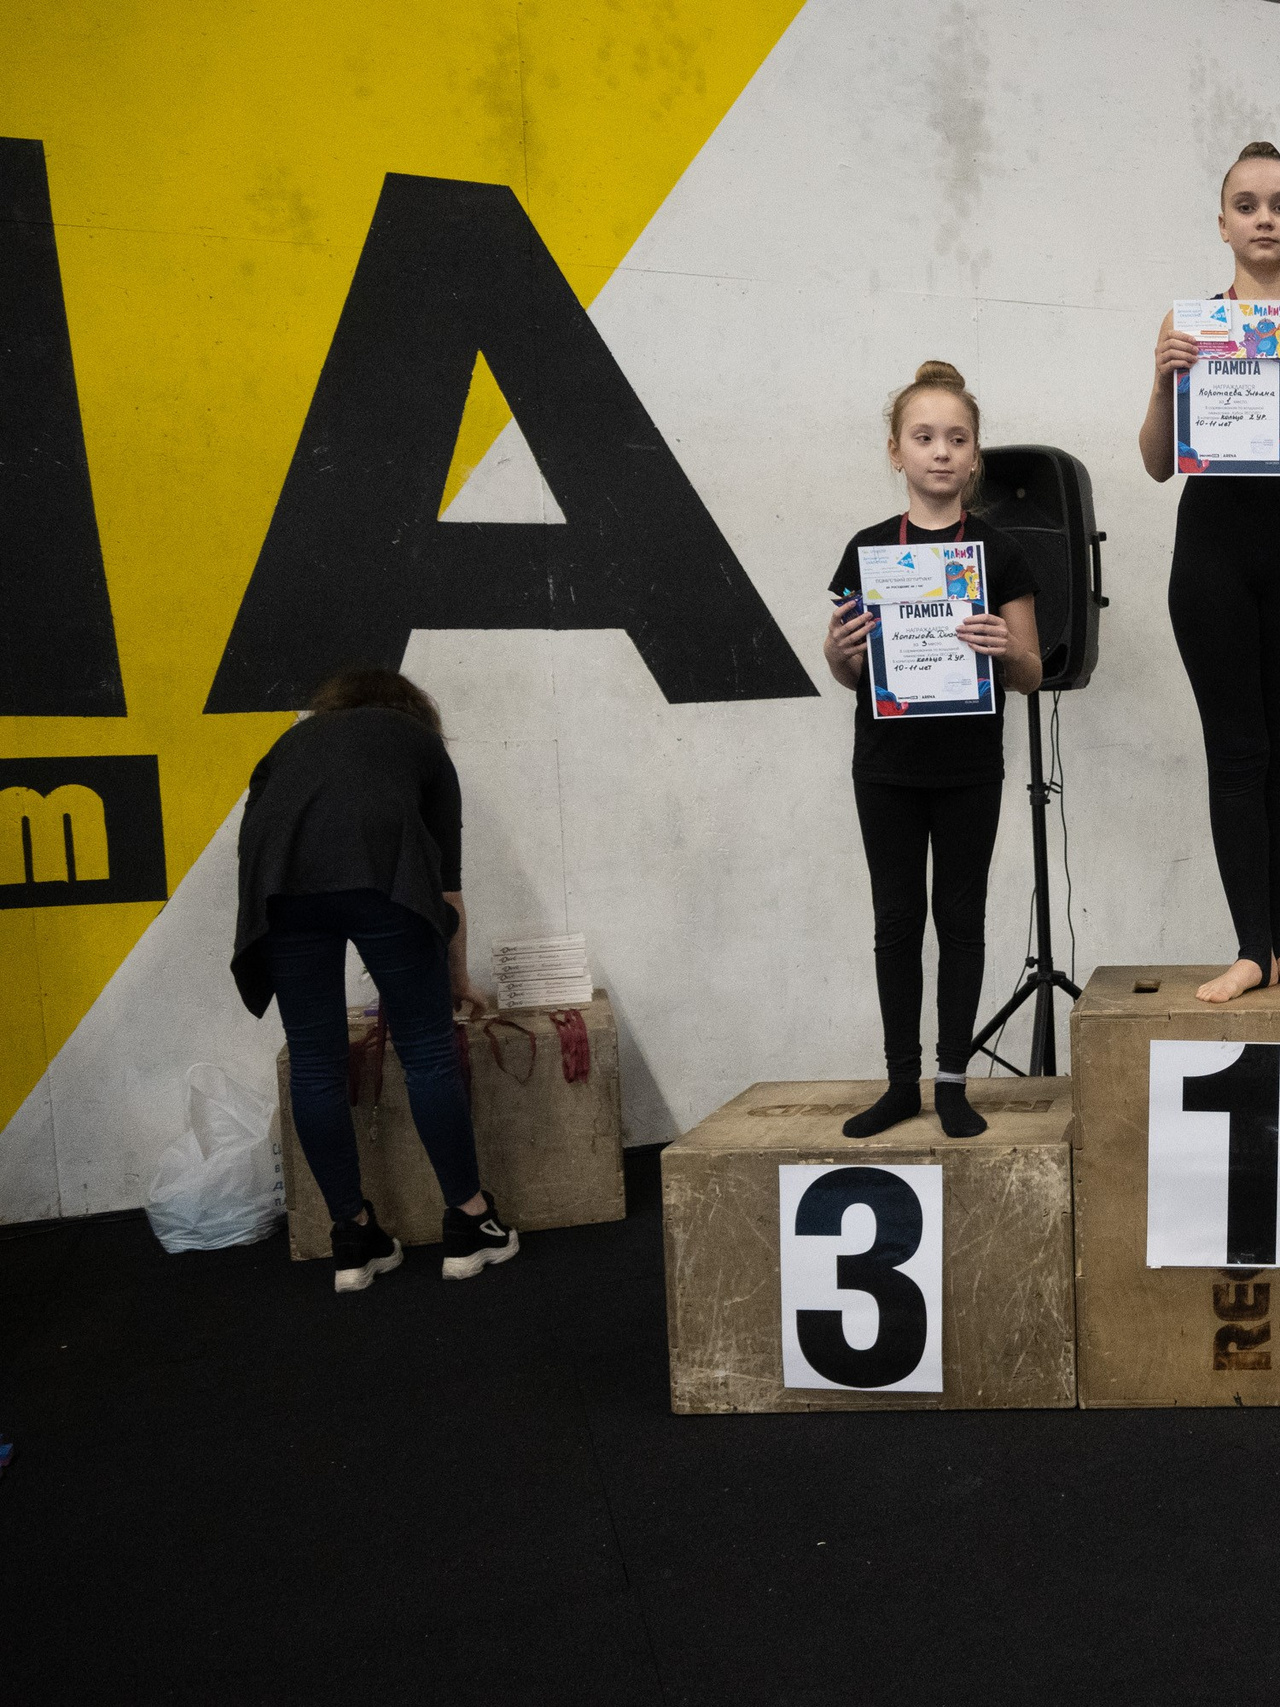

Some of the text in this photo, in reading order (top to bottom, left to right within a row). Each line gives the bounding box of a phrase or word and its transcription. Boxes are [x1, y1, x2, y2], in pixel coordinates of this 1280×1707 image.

[1208, 360, 1260, 375] ГРАМОТА
[900, 603, 953, 619] ГРАМОТА
[1182, 1043, 1280, 1265] 1
[795, 1166, 927, 1388] 3
